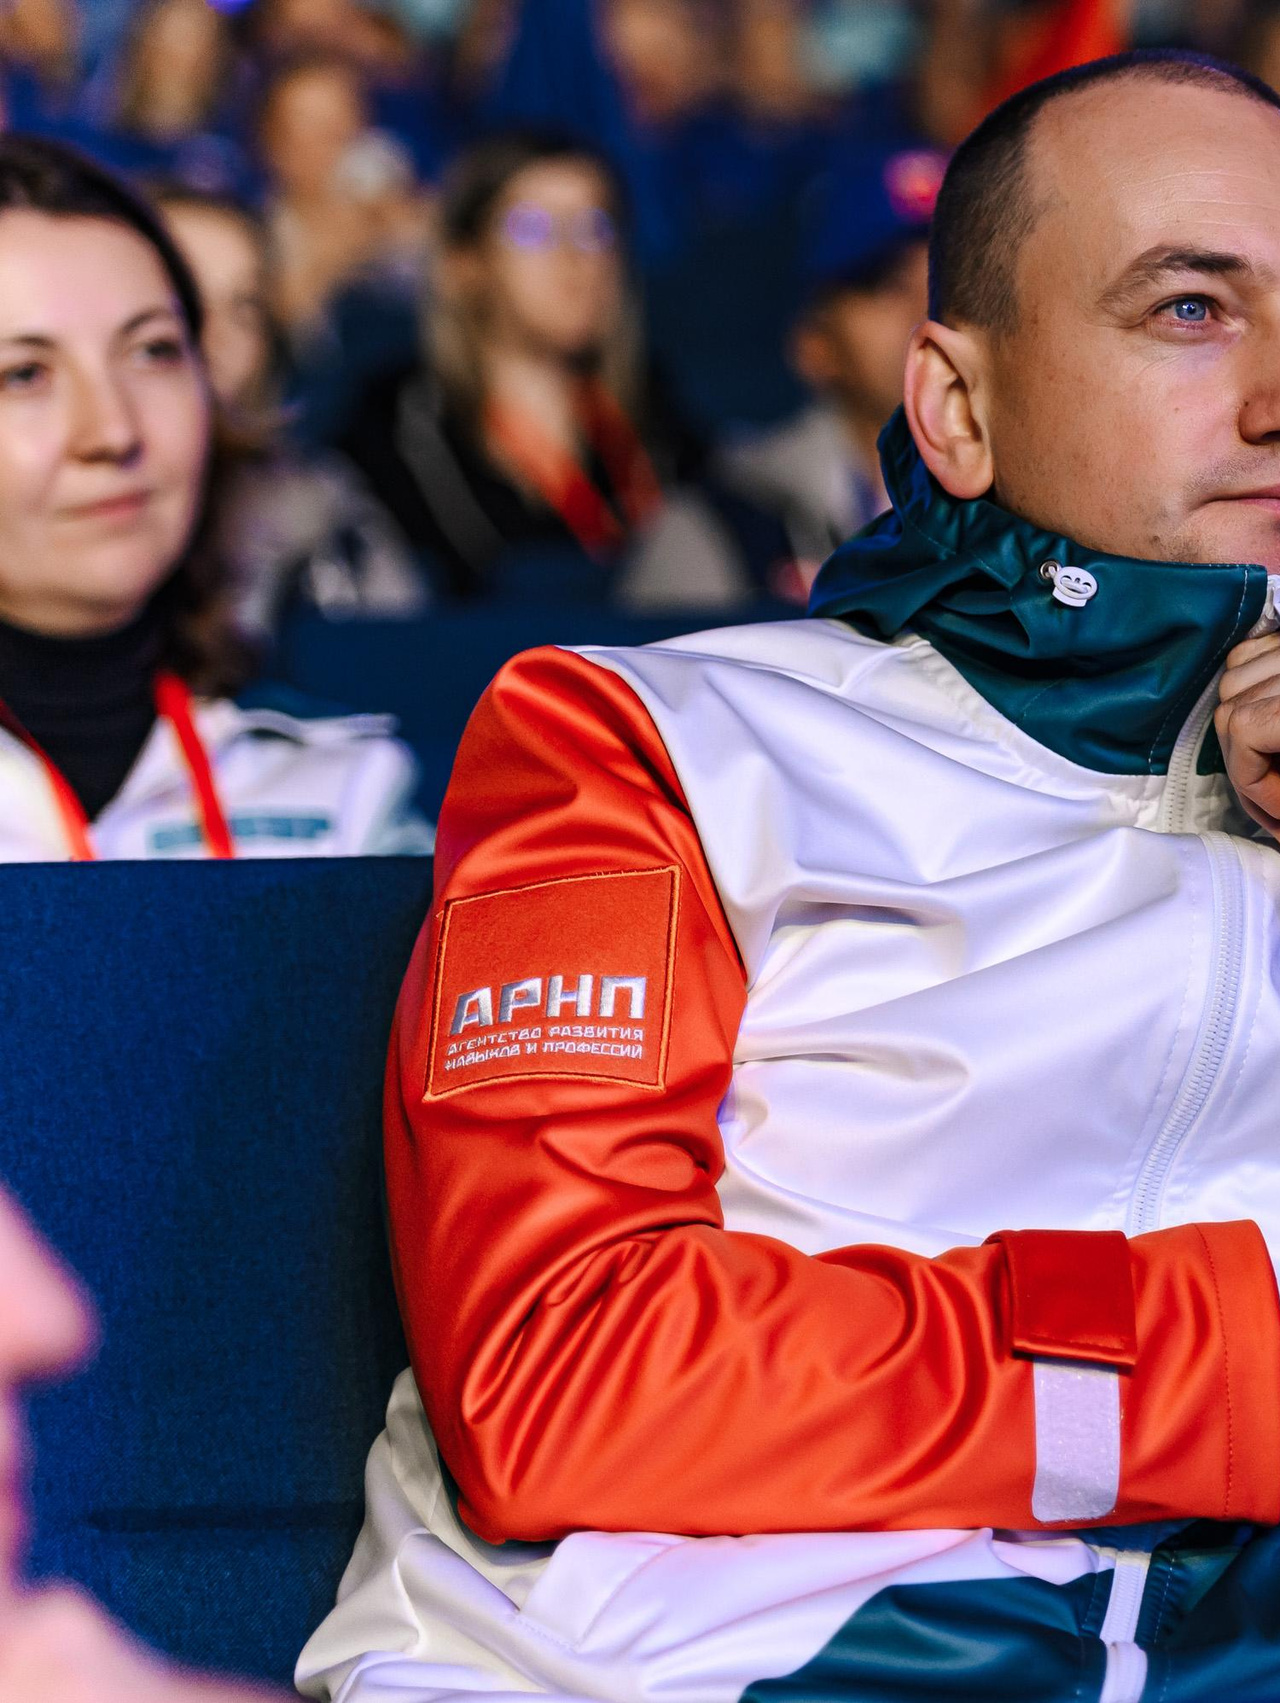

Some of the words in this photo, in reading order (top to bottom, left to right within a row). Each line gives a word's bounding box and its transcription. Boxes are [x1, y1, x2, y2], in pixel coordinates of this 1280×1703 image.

[450, 974, 647, 1035] АРНП
[447, 1027, 542, 1056] АГЕНТСТВО
[549, 1025, 643, 1042] РАЗВИТИЯ
[444, 1043, 521, 1071] НАВЫКОВ
[525, 1042, 538, 1054] И
